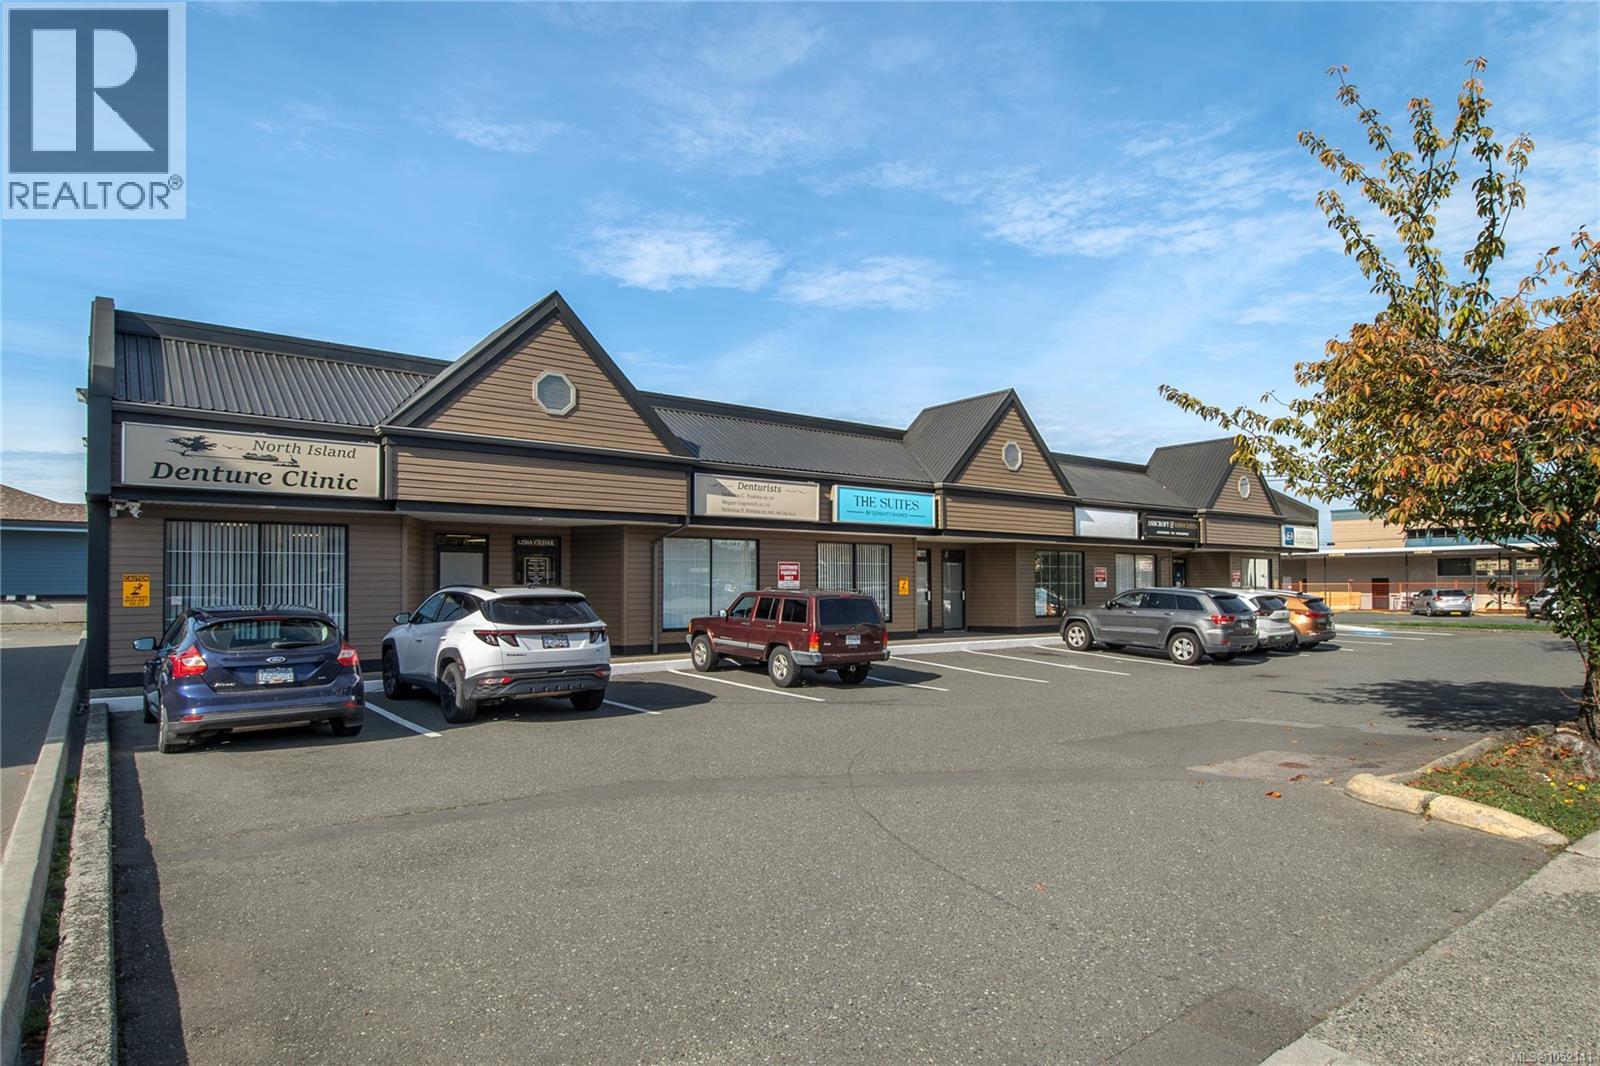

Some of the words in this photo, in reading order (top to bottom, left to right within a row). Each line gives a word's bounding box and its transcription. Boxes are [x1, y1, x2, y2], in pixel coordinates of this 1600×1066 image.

[252, 439, 301, 455] North
[307, 444, 357, 460] Island
[149, 460, 273, 486] Denture
[281, 470, 359, 491] Clinic
[737, 481, 783, 494] Denturists
[853, 494, 877, 508] THE
[879, 497, 920, 511] SUITES
